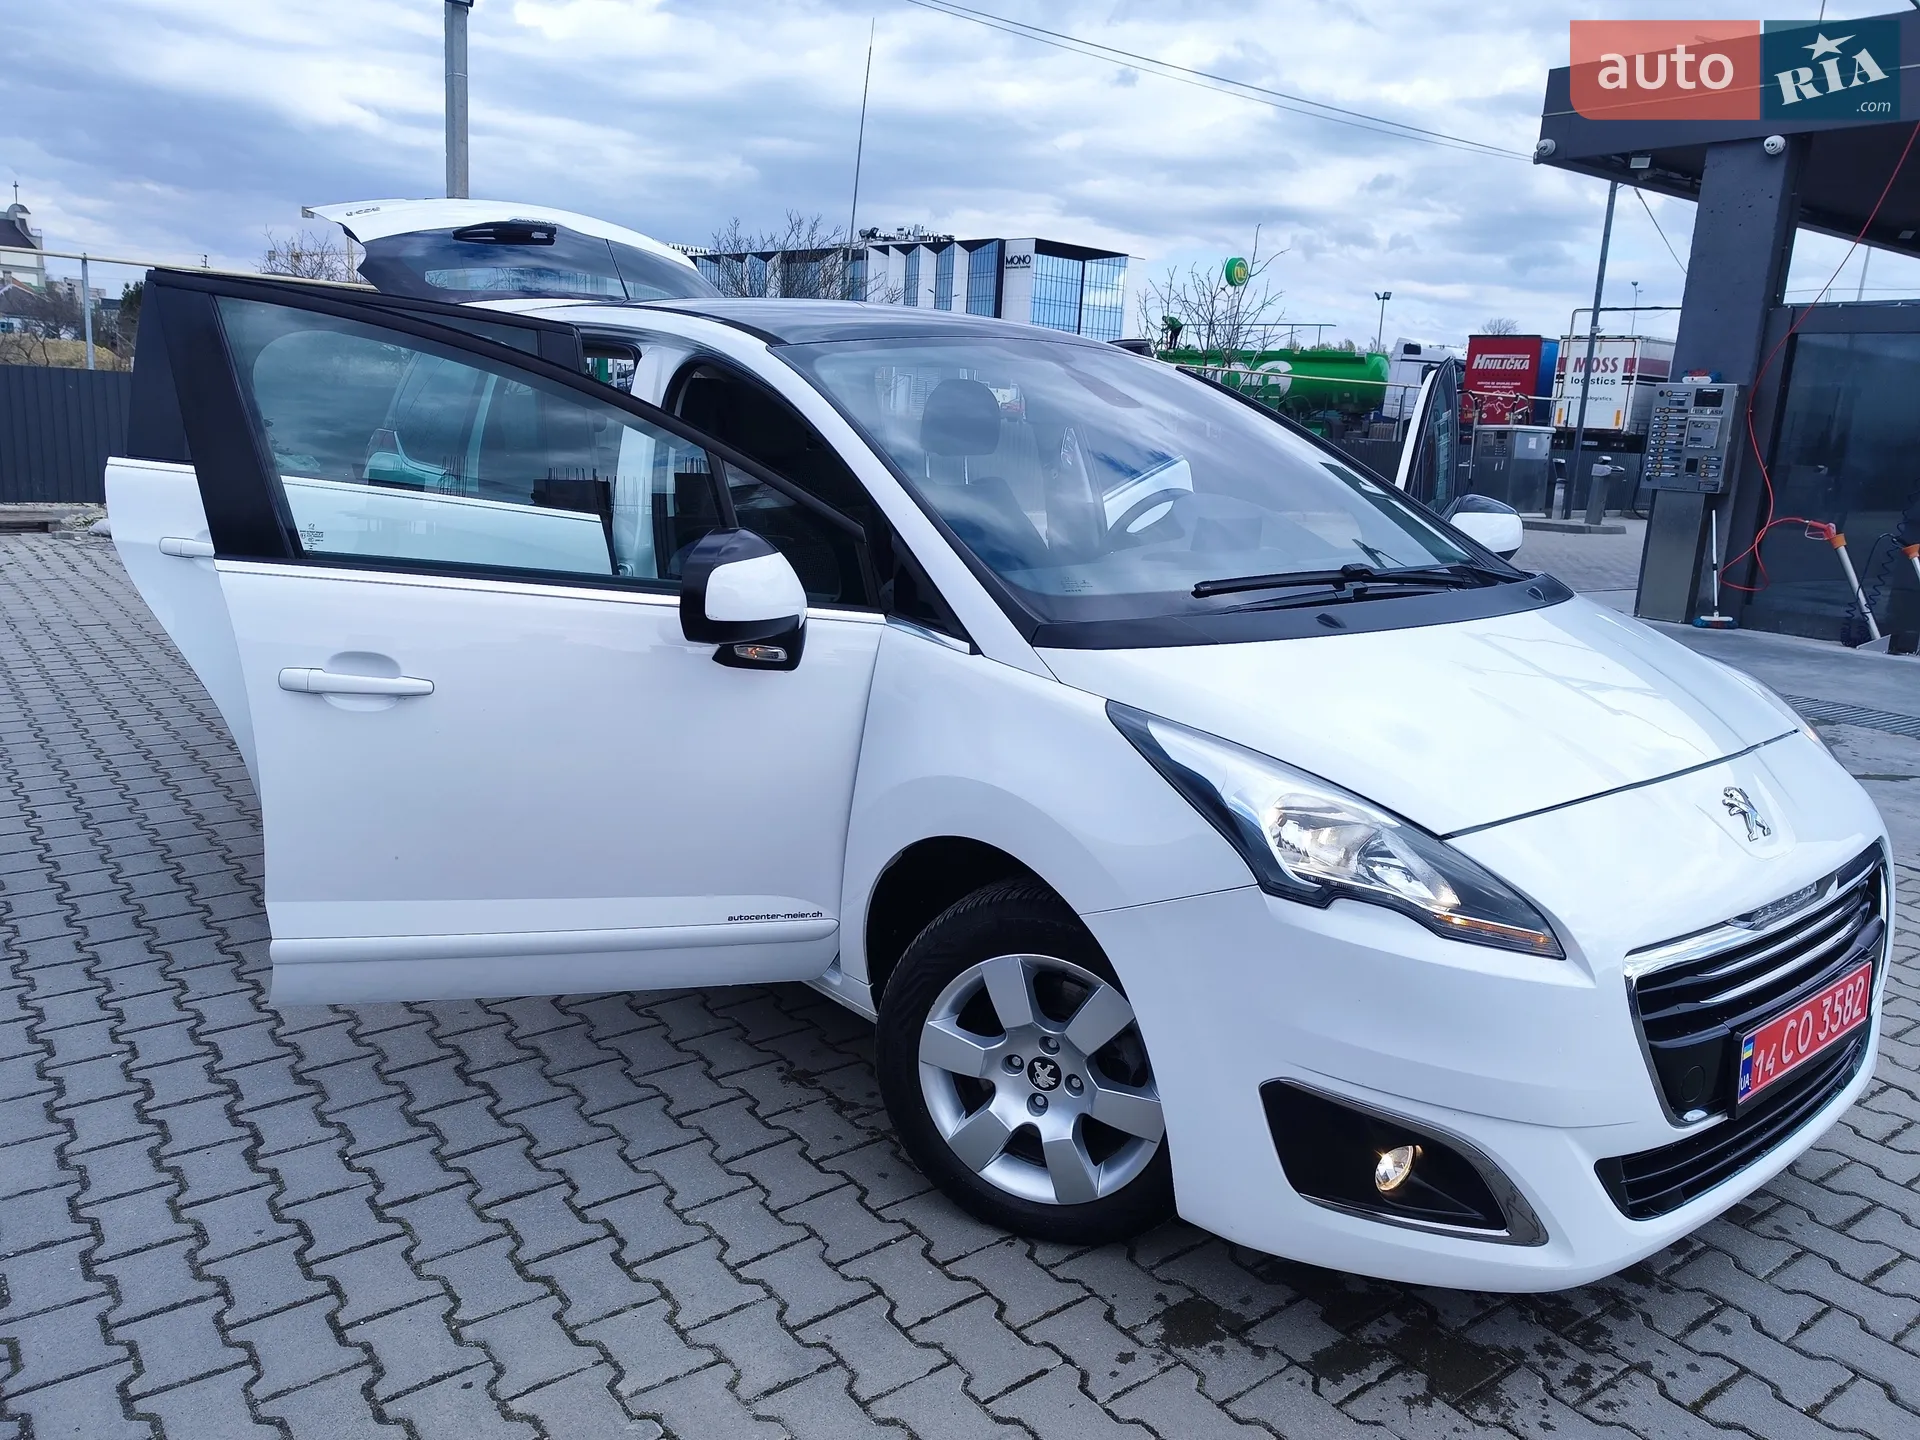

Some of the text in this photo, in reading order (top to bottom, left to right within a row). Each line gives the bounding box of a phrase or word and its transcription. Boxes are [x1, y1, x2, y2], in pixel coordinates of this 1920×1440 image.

[1005, 255, 1031, 265] MONO
[1573, 357, 1619, 373] MOSS
[728, 911, 823, 921] autocenter-meier.ch
[1754, 976, 1865, 1084] 14 CO 3582
[1740, 1076, 1750, 1091] UA
